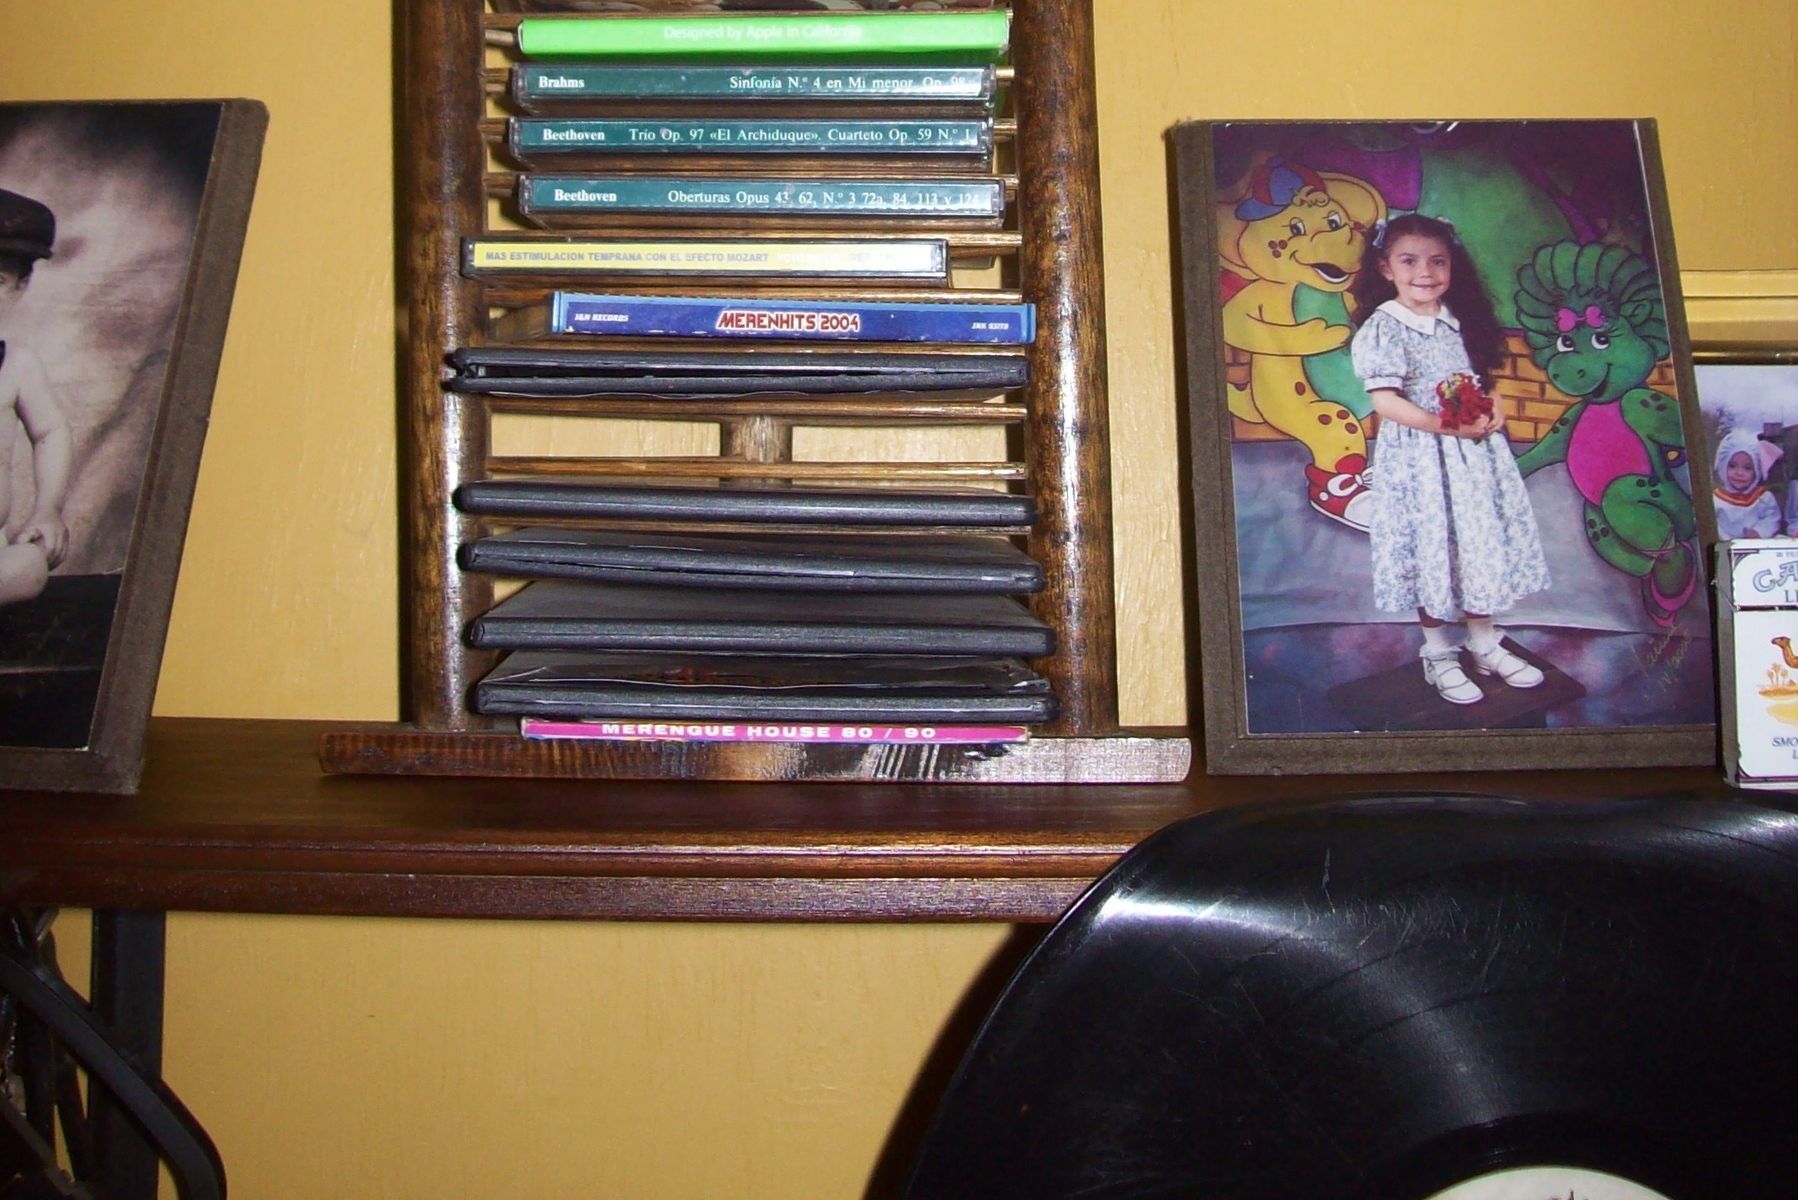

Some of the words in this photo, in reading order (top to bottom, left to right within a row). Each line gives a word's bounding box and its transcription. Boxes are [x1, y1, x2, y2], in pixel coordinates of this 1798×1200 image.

[663, 24, 725, 41] Designed
[727, 24, 743, 41] by
[746, 23, 783, 41] Apple
[786, 24, 799, 36] in
[802, 23, 863, 38] California
[538, 75, 585, 89] Brahms
[729, 75, 782, 89] Sinfonía
[813, 76, 822, 89] 4
[826, 79, 842, 89] en
[848, 76, 866, 89] Mi
[542, 128, 605, 141] Beethoven
[689, 128, 705, 141] 97
[827, 128, 883, 141] Cuarteto
[917, 127, 932, 140] 59
[554, 188, 617, 202] Beethoven
[667, 190, 731, 204] Oberturas
[735, 191, 770, 205] Opus
[798, 191, 817, 206] 62,
[917, 192, 938, 205] 113
[944, 195, 952, 207] y
[485, 251, 506, 261] MAS
[510, 251, 585, 262] ESTIMULACION
[588, 251, 642, 262] TEMPRANA
[646, 252, 667, 262] CON
[670, 252, 682, 262] EL
[685, 252, 724, 262] EFECTO
[727, 252, 769, 263] MOZART
[717, 311, 817, 330] MERENHITS
[819, 313, 860, 332] 2004
[601, 723, 736, 738] MERENGUE
[749, 725, 831, 739] HOUSE
[841, 726, 873, 739] 80
[883, 727, 892, 739] /
[904, 726, 936, 739] 90
